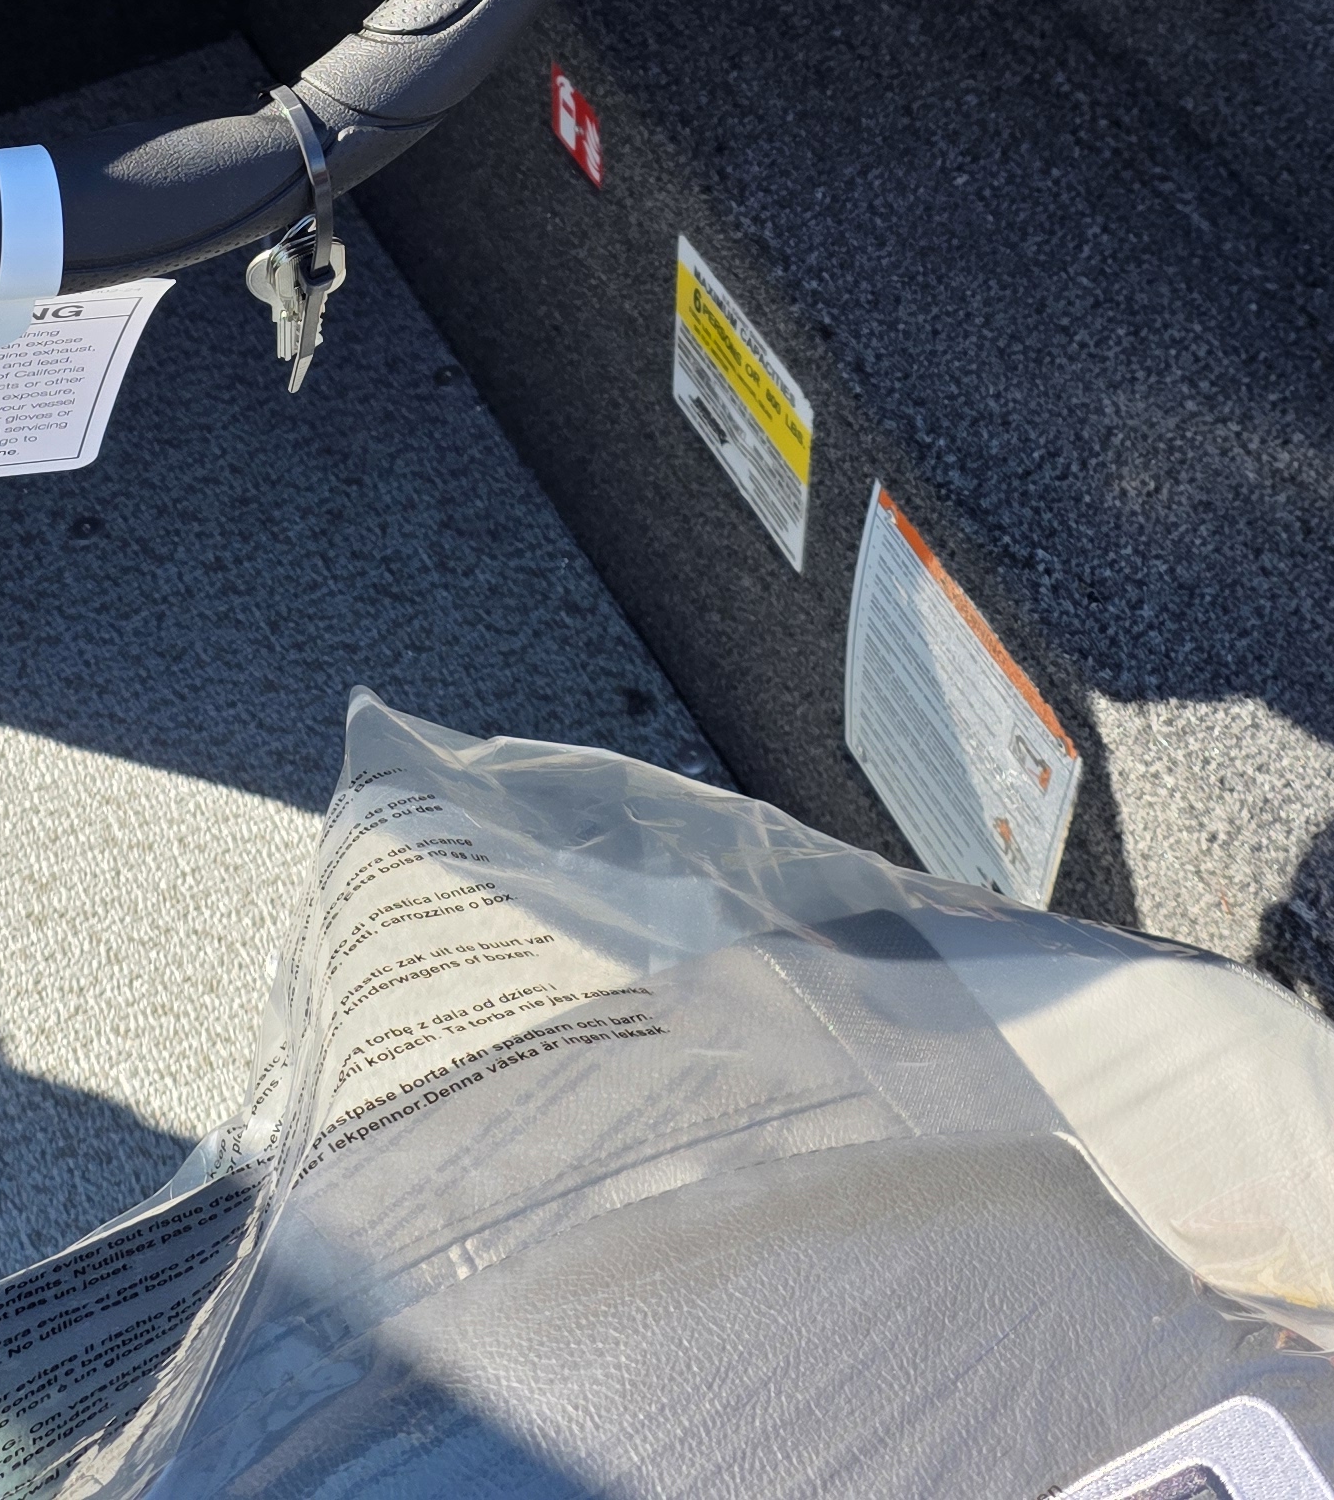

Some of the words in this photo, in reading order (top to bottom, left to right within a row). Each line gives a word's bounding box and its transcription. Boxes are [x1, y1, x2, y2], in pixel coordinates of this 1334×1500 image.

[32, 345, 96, 357] exhaust,
[692, 287, 702, 315] 6
[702, 305, 743, 367] PERSONS
[745, 362, 761, 389] OR
[693, 264, 738, 331] MAXIMUM
[740, 327, 797, 409] CAPACITIES
[14, 365, 86, 378] California
[1, 387, 76, 402] exposure,
[31, 398, 76, 410] vessel
[5, 411, 54, 425] gloves
[378, 854, 425, 874] bolsa
[368, 894, 433, 922] plastica
[435, 881, 496, 901] lontano
[380, 904, 465, 928] carrozzine
[340, 964, 394, 1006] plastic
[395, 953, 427, 969] zak
[430, 947, 454, 959] uit
[455, 943, 476, 953] de
[525, 932, 555, 946] van
[343, 958, 461, 1016] kinderwagens
[464, 954, 482, 966] of
[483, 948, 540, 963] boxen.
[431, 1007, 469, 1026] dala
[472, 998, 496, 1013] od
[498, 983, 549, 1004] dzieci
[365, 1032, 442, 1068] kojcach.
[442, 1024, 467, 1036] Ta
[468, 1009, 516, 1028] torba
[518, 999, 546, 1012] nie
[546, 993, 577, 1007] jest
[486, 1048, 540, 1074] väska
[542, 1041, 560, 1052] är
[563, 1032, 610, 1045] ingen
[611, 1024, 671, 1040] leksak.
[399, 1067, 450, 1095] borta
[451, 1047, 489, 1070] från
[492, 1022, 573, 1052] spädbarn
[576, 1017, 608, 1030] och
[608, 1011, 654, 1026] barn.
[7, 1341, 34, 1359] No
